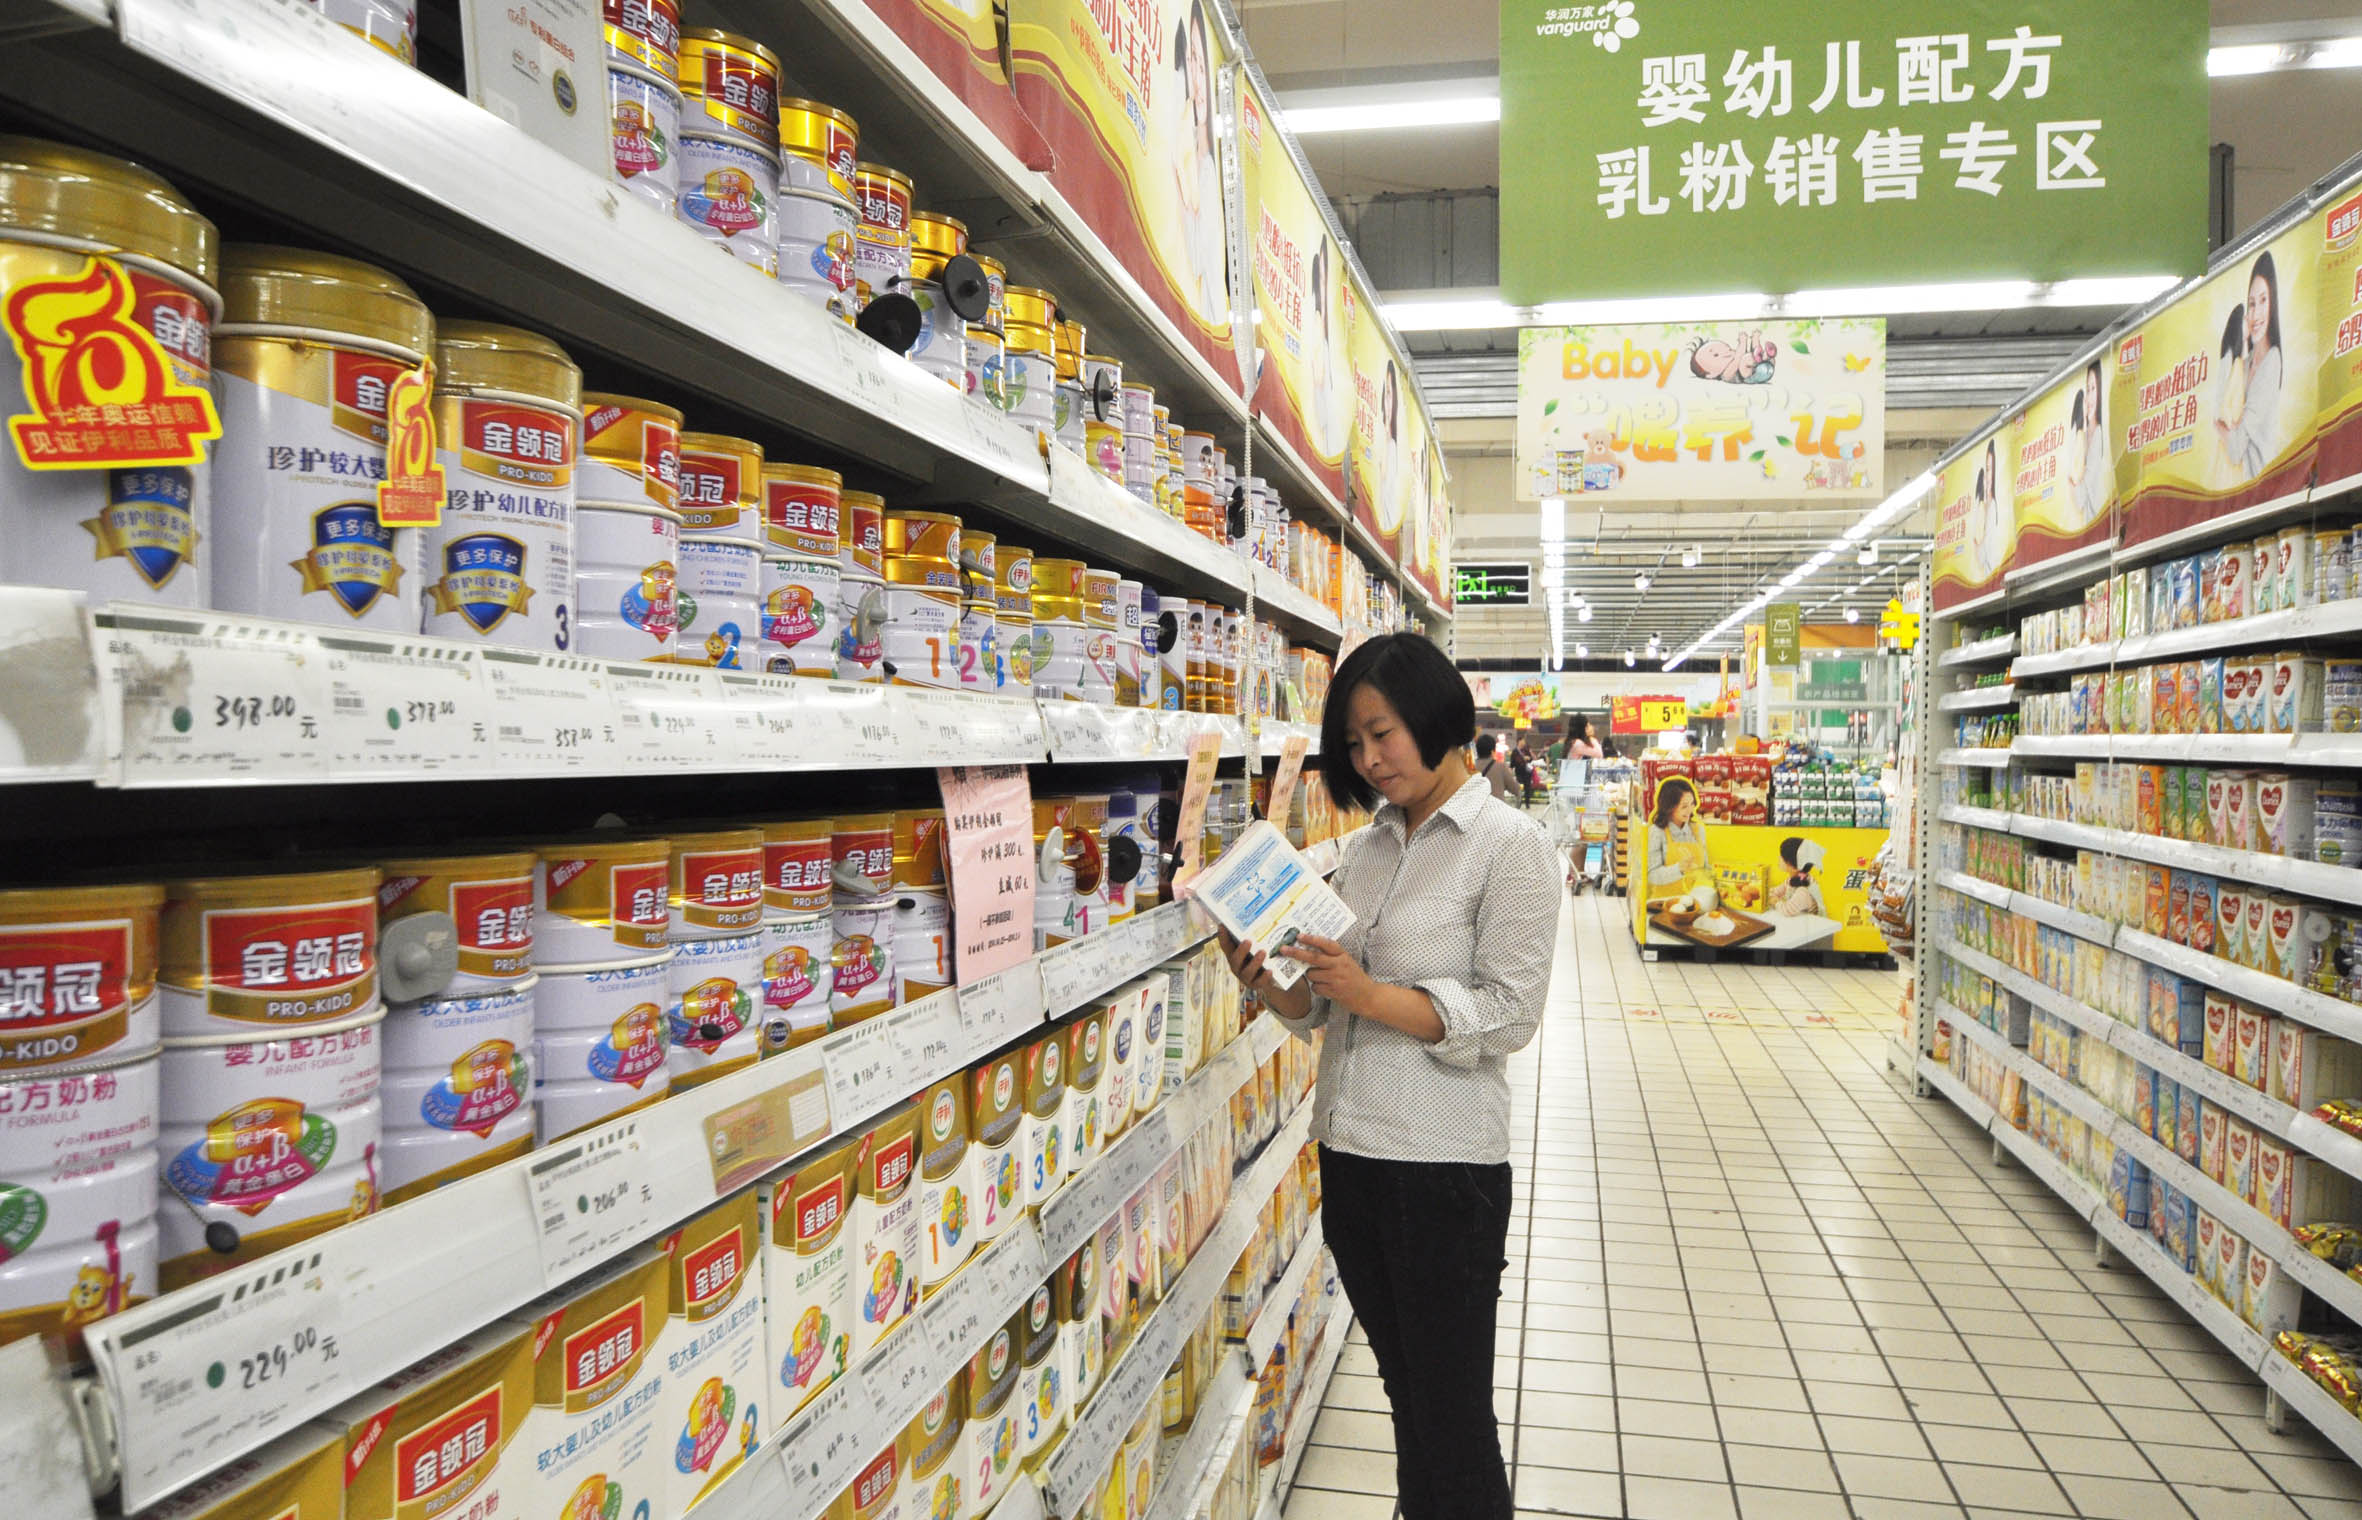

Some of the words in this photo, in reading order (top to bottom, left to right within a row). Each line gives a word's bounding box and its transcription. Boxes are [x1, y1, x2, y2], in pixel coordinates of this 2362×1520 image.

[1536, 14, 1611, 37] vanguard
[1545, 6, 1595, 22] 华润万家
[1637, 26, 2062, 127] 婴幼儿配方
[1596, 120, 2105, 219] 乳粉销售专区
[1562, 338, 1678, 388] Baby
[51, 402, 199, 426] 十年奥运信赖
[29, 428, 182, 455] 见证伊利品质
[483, 421, 563, 464] 金领冠
[120, 473, 190, 501] 更多保护
[499, 465, 554, 483] PRO-KIDO
[325, 519, 391, 542] 更多保护
[456, 548, 518, 568] 更多保护
[554, 603, 570, 652] 3
[715, 621, 743, 669] 2
[925, 637, 940, 679] 1
[960, 643, 978, 683] 2
[1163, 686, 1179, 711] 3
[299, 715, 318, 740] 元
[1063, 899, 1075, 933] 4
[1075, 905, 1088, 935] 1
[241, 931, 365, 987] 金领冠
[932, 935, 943, 976] 1
[266, 992, 353, 1018] PRO-KIDO
[234, 1128, 274, 1150] 保护
[1073, 1123, 1084, 1158] 4
[221, 1161, 306, 1196] 黄金蛋白
[880, 1150, 909, 1187] 金领冠
[1033, 1153, 1044, 1192] 3
[802, 1194, 838, 1237] 金领冠
[985, 1184, 997, 1227] 2
[928, 1222, 939, 1265] 1
[694, 1249, 737, 1300] 金领冠
[239, 1327, 317, 1390] 229.00
[577, 1326, 634, 1388] 金领冠
[1077, 1353, 1087, 1386] 4
[536, 1375, 663, 1473] 较大婴儿及幼儿配方奶粉
[742, 1402, 760, 1461] 2
[1027, 1401, 1039, 1441] 3
[413, 1418, 488, 1497] 金领冠
[978, 1455, 992, 1500] 2
